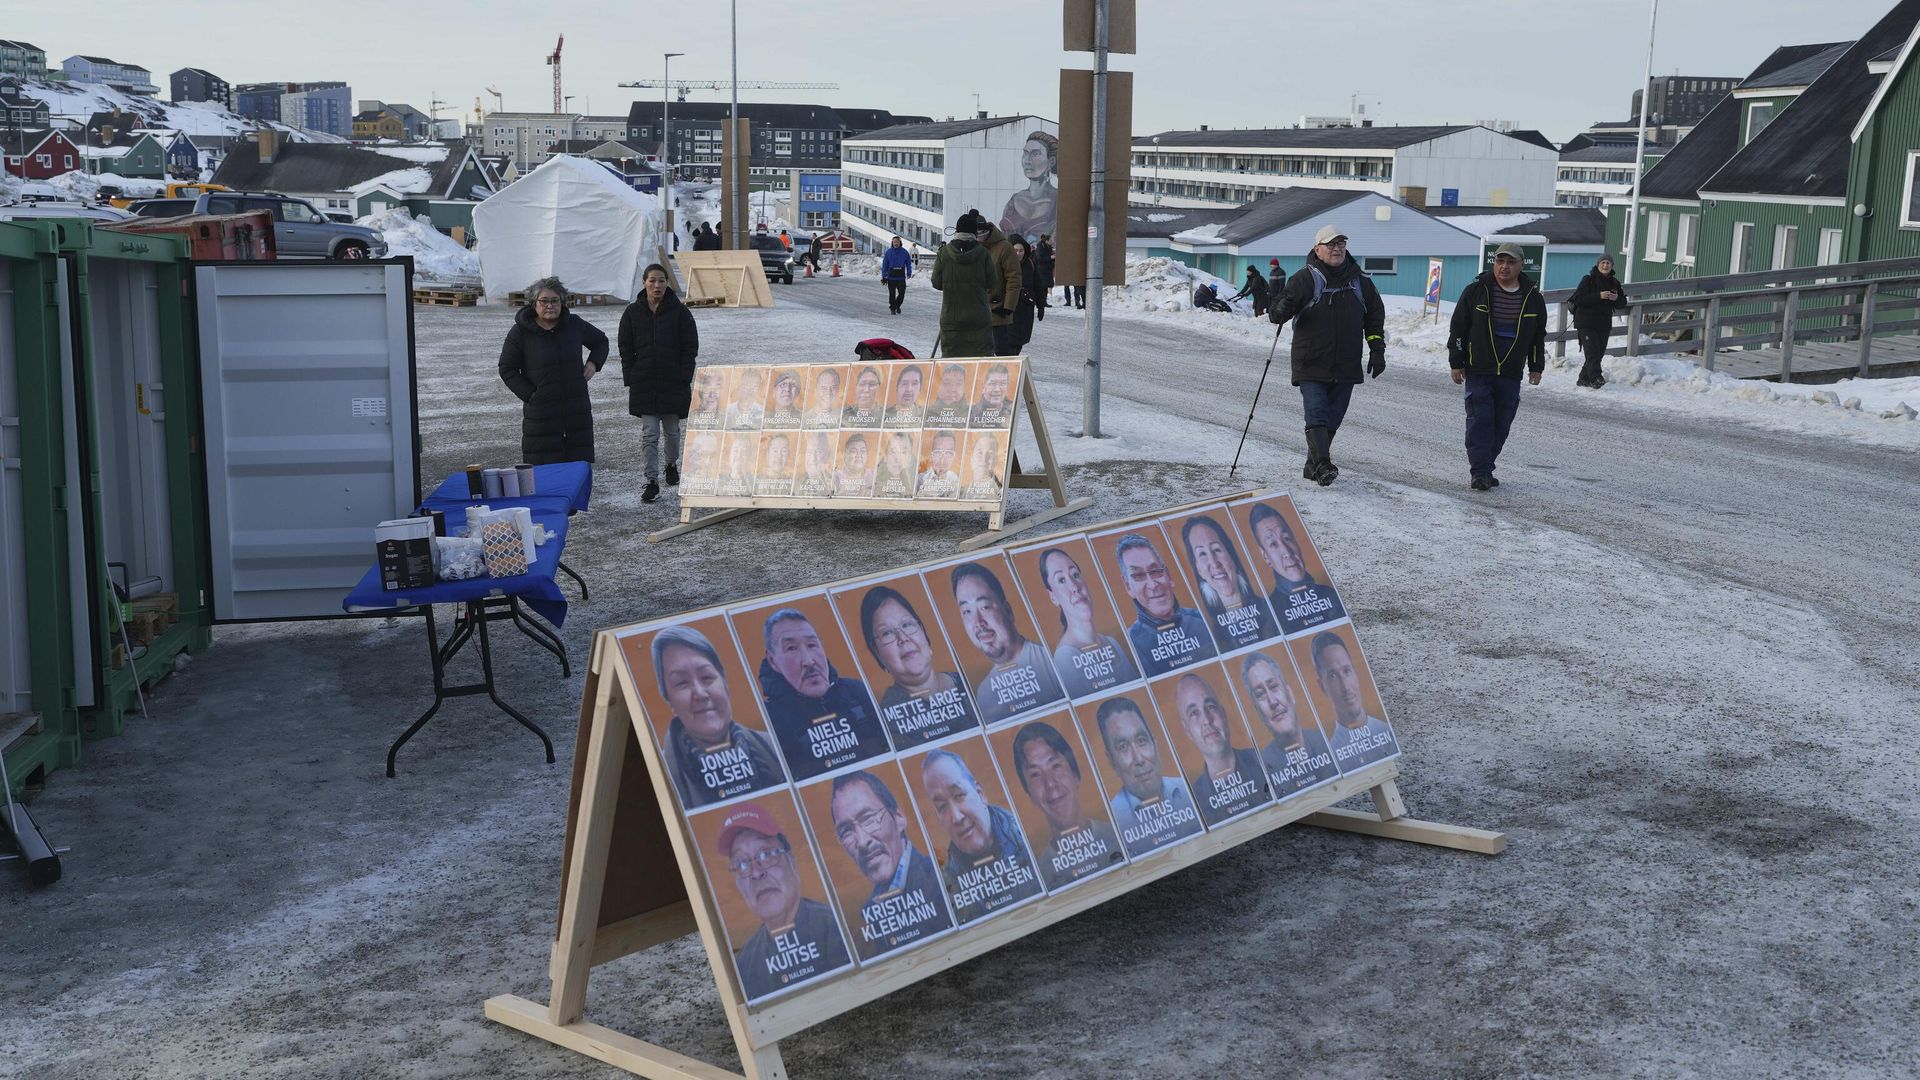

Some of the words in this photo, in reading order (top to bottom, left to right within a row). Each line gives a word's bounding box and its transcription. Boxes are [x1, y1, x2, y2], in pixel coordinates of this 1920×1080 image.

[973, 416, 1006, 424] FLEISCHER
[1284, 597, 1333, 622] SIMONSEN
[1290, 589, 1318, 607] SILAS
[1216, 604, 1261, 628] QUPANUK
[1228, 618, 1260, 637] OLSEN
[1150, 636, 1201, 663] BENTZEN
[1157, 627, 1185, 647] AGGU
[1072, 645, 1116, 670] DORTHE
[1084, 659, 1115, 681] QVIST
[990, 665, 1037, 692] ANDERS
[997, 678, 1042, 705] JENSEN
[883, 697, 927, 723] METTE
[895, 701, 967, 735] HAMMEKEN
[807, 717, 851, 743] NIELS
[1348, 725, 1371, 743] JUNO
[811, 731, 860, 759] GRIMM
[1285, 747, 1309, 767] JENS
[1335, 730, 1393, 761] BERTHELSEN
[700, 746, 749, 773] JONNA
[1270, 752, 1332, 786] NAPAATTOOQ
[703, 761, 754, 789] OLSEN
[1213, 771, 1242, 794] PILOU
[1208, 780, 1258, 809] CHEMNITZ
[1123, 806, 1196, 844] QUJAUKITSOQ
[1134, 800, 1174, 823] VITTUS
[1056, 828, 1095, 855] JOHAN
[1051, 839, 1108, 873] ROSBACH
[957, 865, 992, 890] NUKA
[993, 855, 1019, 876] OLE
[953, 866, 1033, 910] BERTHELSEN
[861, 888, 926, 924] KRISTIAN
[860, 902, 938, 942] KLEEMANN
[774, 930, 800, 953] ELI
[764, 941, 821, 975] KUITSE
